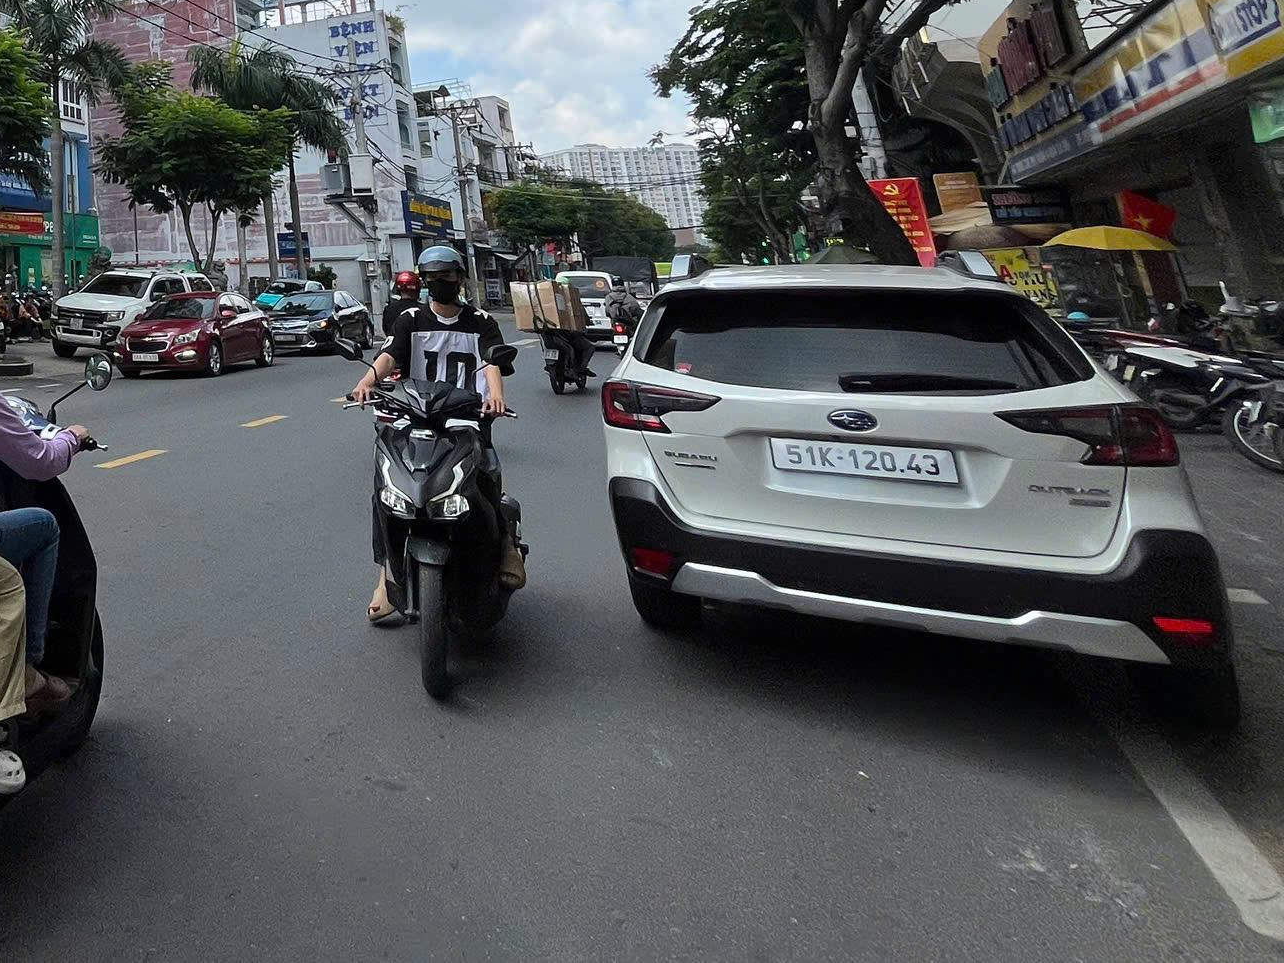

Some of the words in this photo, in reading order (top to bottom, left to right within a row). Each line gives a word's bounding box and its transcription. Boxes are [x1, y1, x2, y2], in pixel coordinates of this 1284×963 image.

[329, 20, 375, 38] BỆNH
[334, 41, 375, 57] VỆN
[424, 349, 477, 393] 10
[664, 450, 718, 462] SUBARU
[786, 444, 941, 476] 51K-120.43
